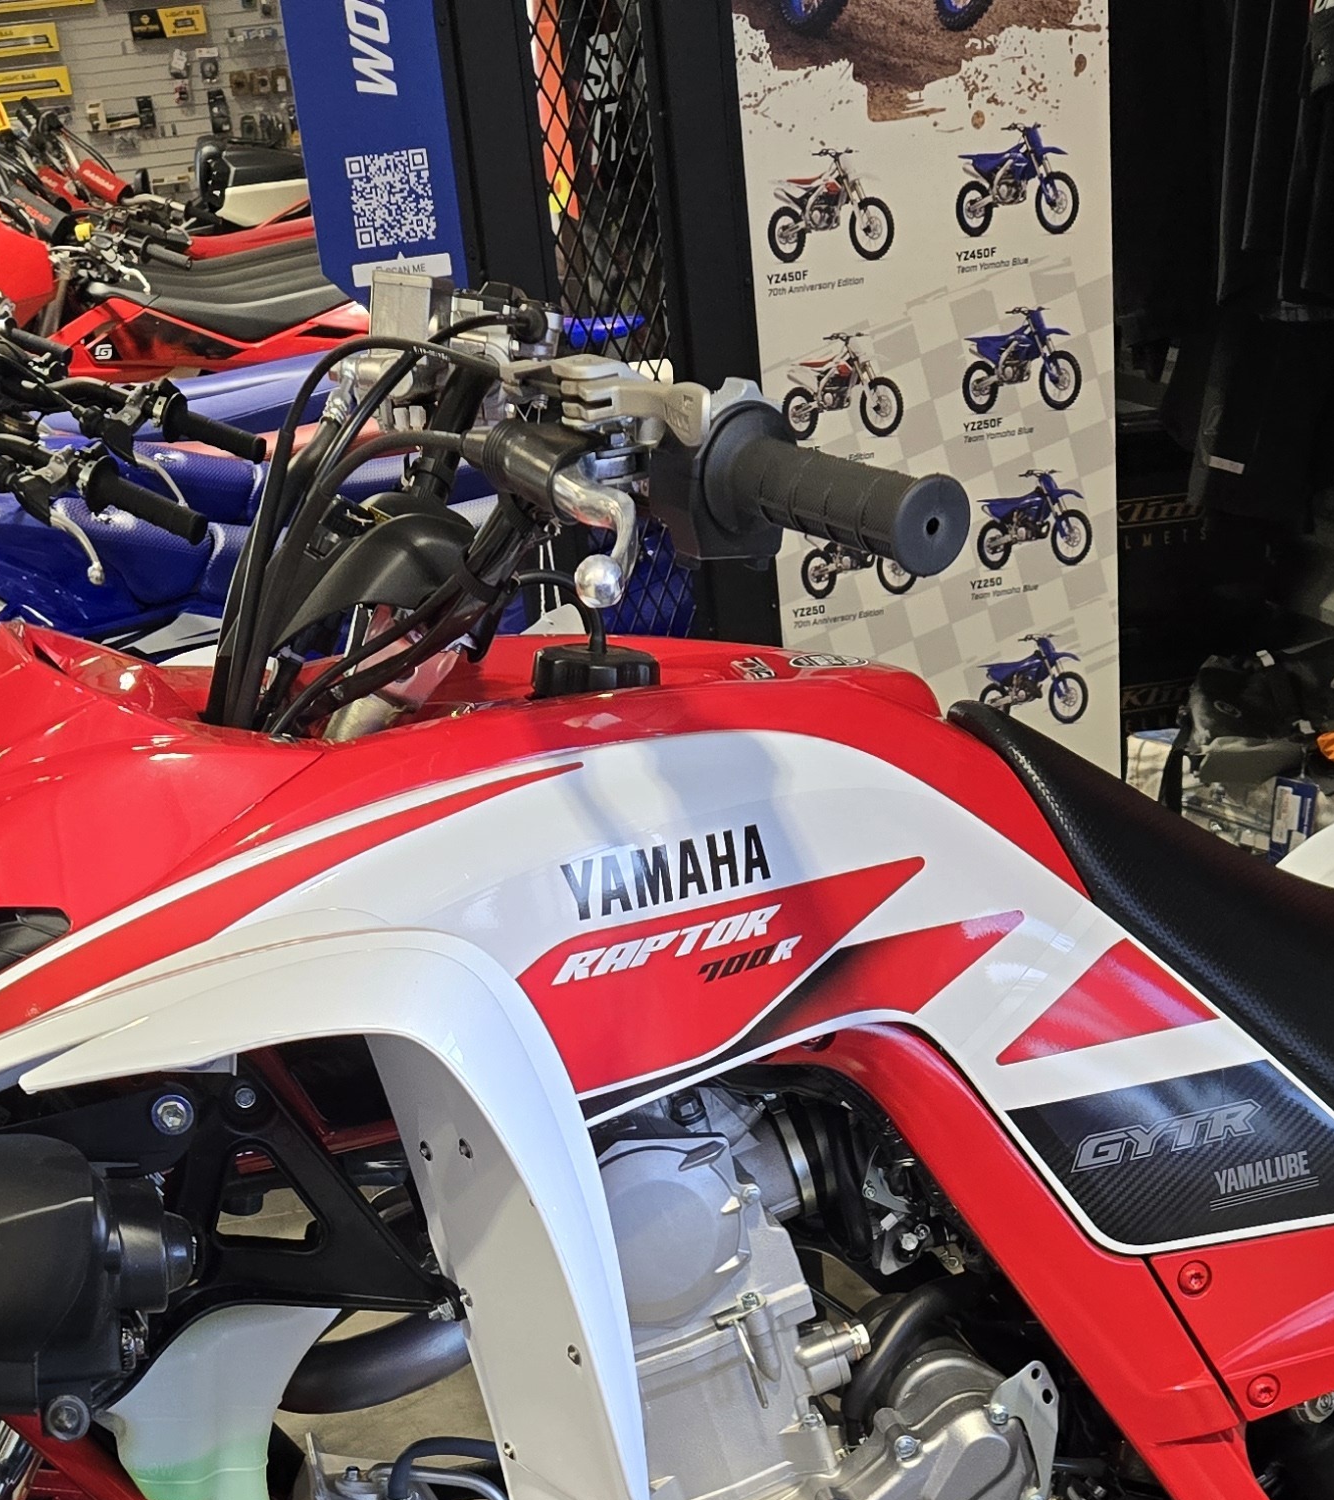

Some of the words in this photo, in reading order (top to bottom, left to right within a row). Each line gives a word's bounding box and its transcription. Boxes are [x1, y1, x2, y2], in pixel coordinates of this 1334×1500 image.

[343, 0, 398, 96] WO
[956, 247, 998, 262] YZ450F
[412, 263, 426, 273] ME
[956, 263, 979, 275] Team
[979, 259, 1012, 273] Yamaha
[1012, 257, 1030, 268] Blue
[767, 270, 809, 285] YZ450F
[768, 285, 788, 297] 70th
[788, 278, 837, 295] Anniversary
[837, 276, 865, 288] Edition
[963, 417, 1004, 432] YZ250F
[963, 434, 985, 444] Team
[985, 430, 1017, 442] Yamaha
[1017, 426, 1035, 436] Blue
[848, 451, 875, 462] Edition
[1124, 528, 1208, 551] LMETS
[969, 577, 1003, 591] YZ250
[970, 591, 992, 602] Team
[992, 587, 1022, 599] Yamaha
[1022, 583, 1040, 594] Blue
[792, 604, 826, 619] YZ250
[793, 619, 812, 630] 70th
[811, 612, 859, 627] Anniversary
[858, 607, 885, 619] Edition
[561, 824, 772, 922] YAMAHA
[551, 904, 782, 987] RAPTOR
[698, 934, 803, 985] 700R
[1072, 1098, 1262, 1173] GYTR
[1213, 1150, 1310, 1191] YAMALUBE
